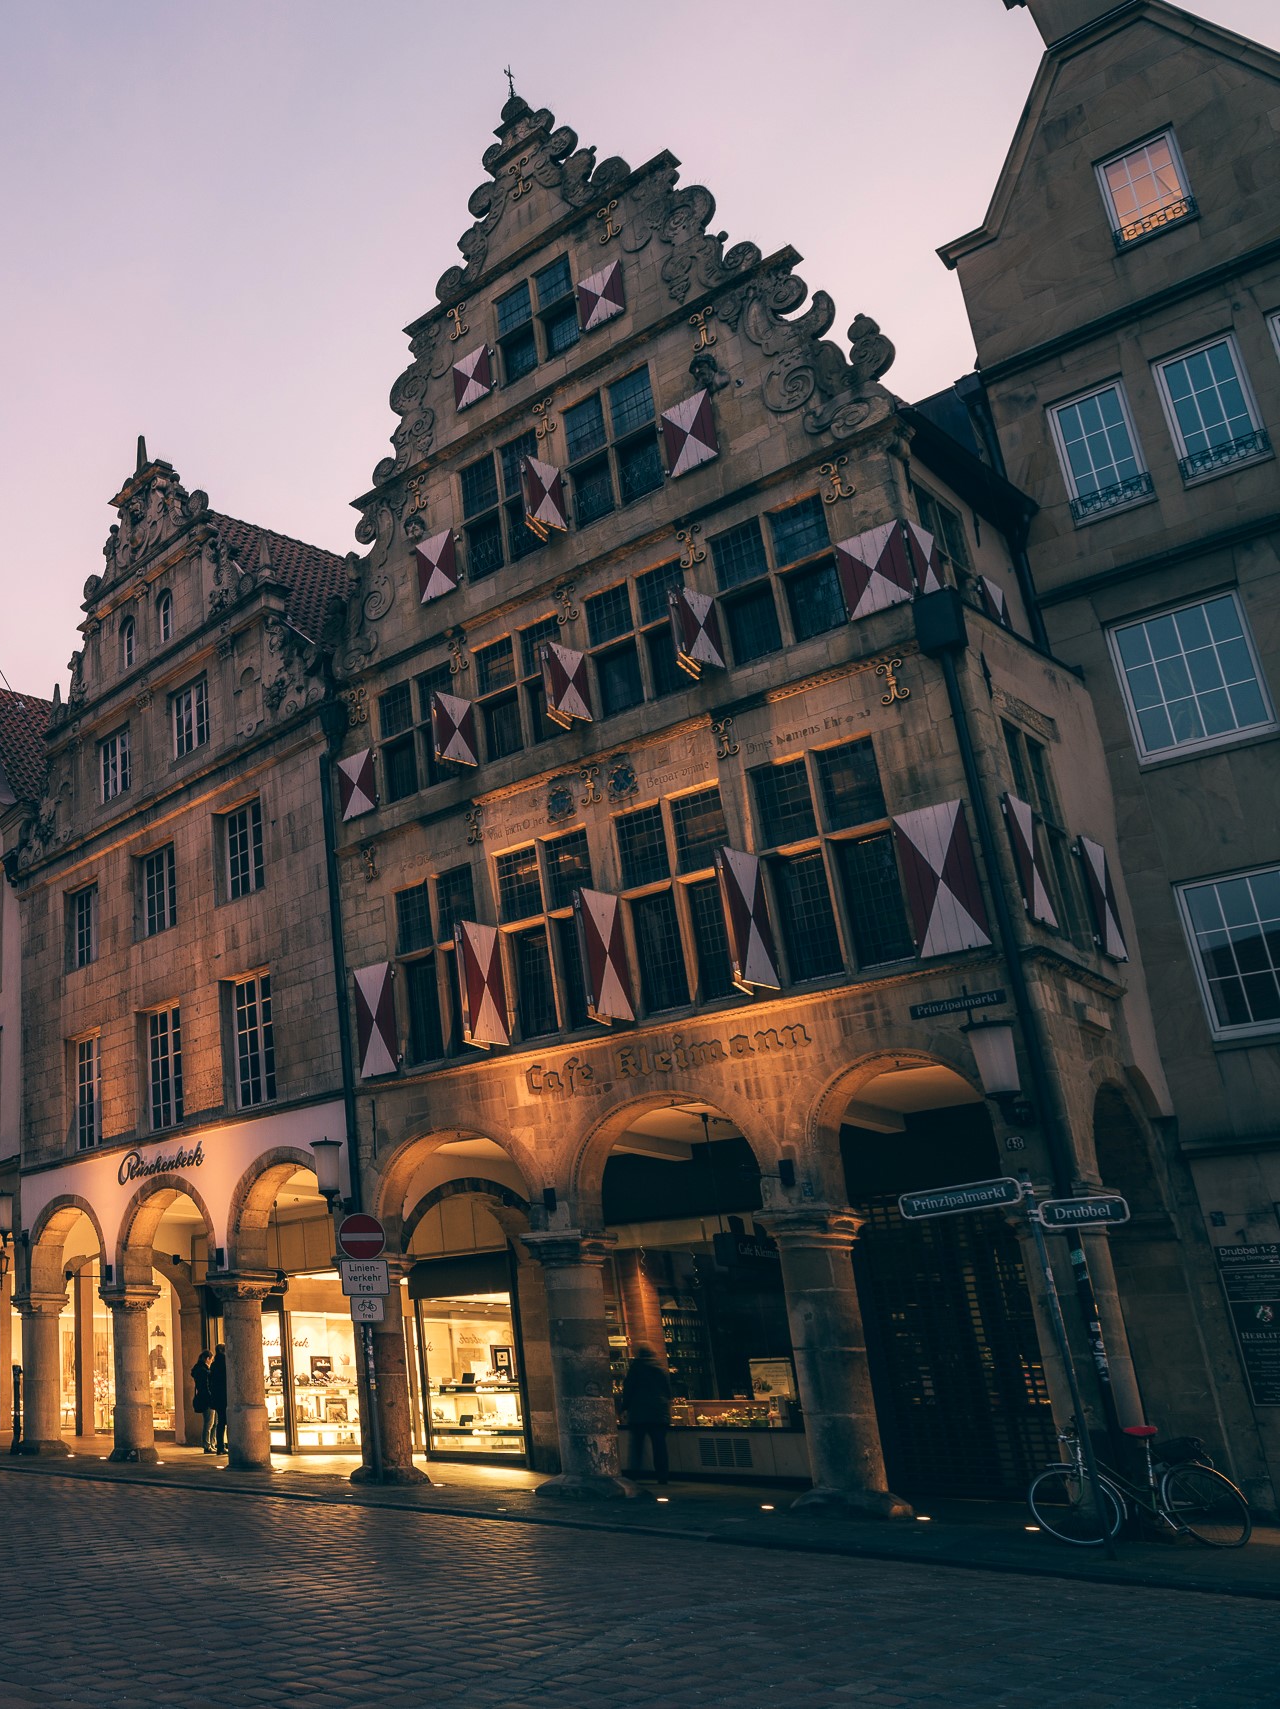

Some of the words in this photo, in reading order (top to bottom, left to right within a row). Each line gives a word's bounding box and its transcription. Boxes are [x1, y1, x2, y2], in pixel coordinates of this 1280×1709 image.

[917, 992, 998, 1016] Prinzipalmarkt
[615, 1022, 812, 1080] Kleimann
[912, 1187, 1008, 1212] Prinzipalmarkt
[1054, 1204, 1112, 1221] Drubbel
[1219, 1246, 1259, 1256] Drubbel
[349, 1264, 380, 1272] Linien-
[348, 1273, 382, 1282] verkehr
[359, 1283, 374, 1292] frei
